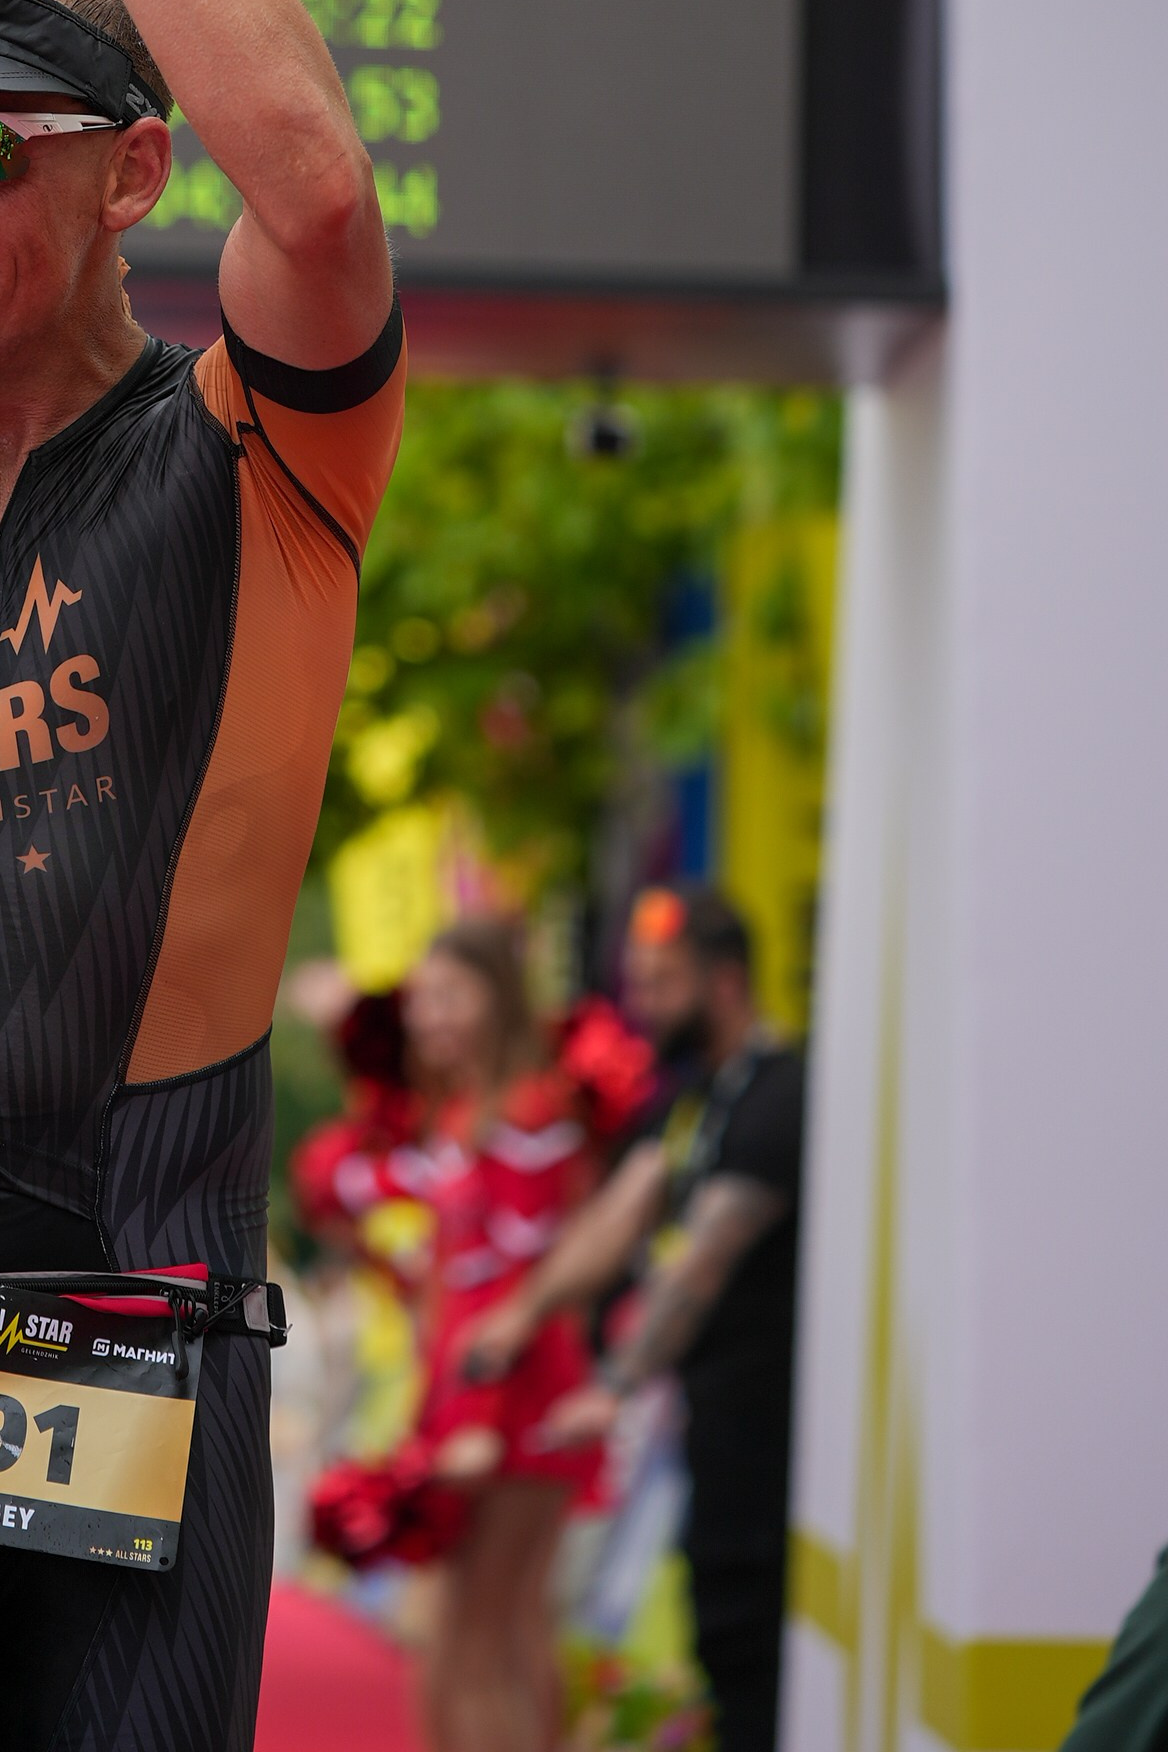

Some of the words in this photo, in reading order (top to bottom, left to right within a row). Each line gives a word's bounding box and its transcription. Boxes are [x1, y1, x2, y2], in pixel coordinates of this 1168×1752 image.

[25, 1314, 74, 1344] STAR
[20, 1347, 59, 1360] GELENDZHIK
[113, 1343, 176, 1365] МАГНИТ
[133, 1538, 153, 1551] 113
[115, 1550, 128, 1560] ALL
[129, 1551, 152, 1563] STARS
